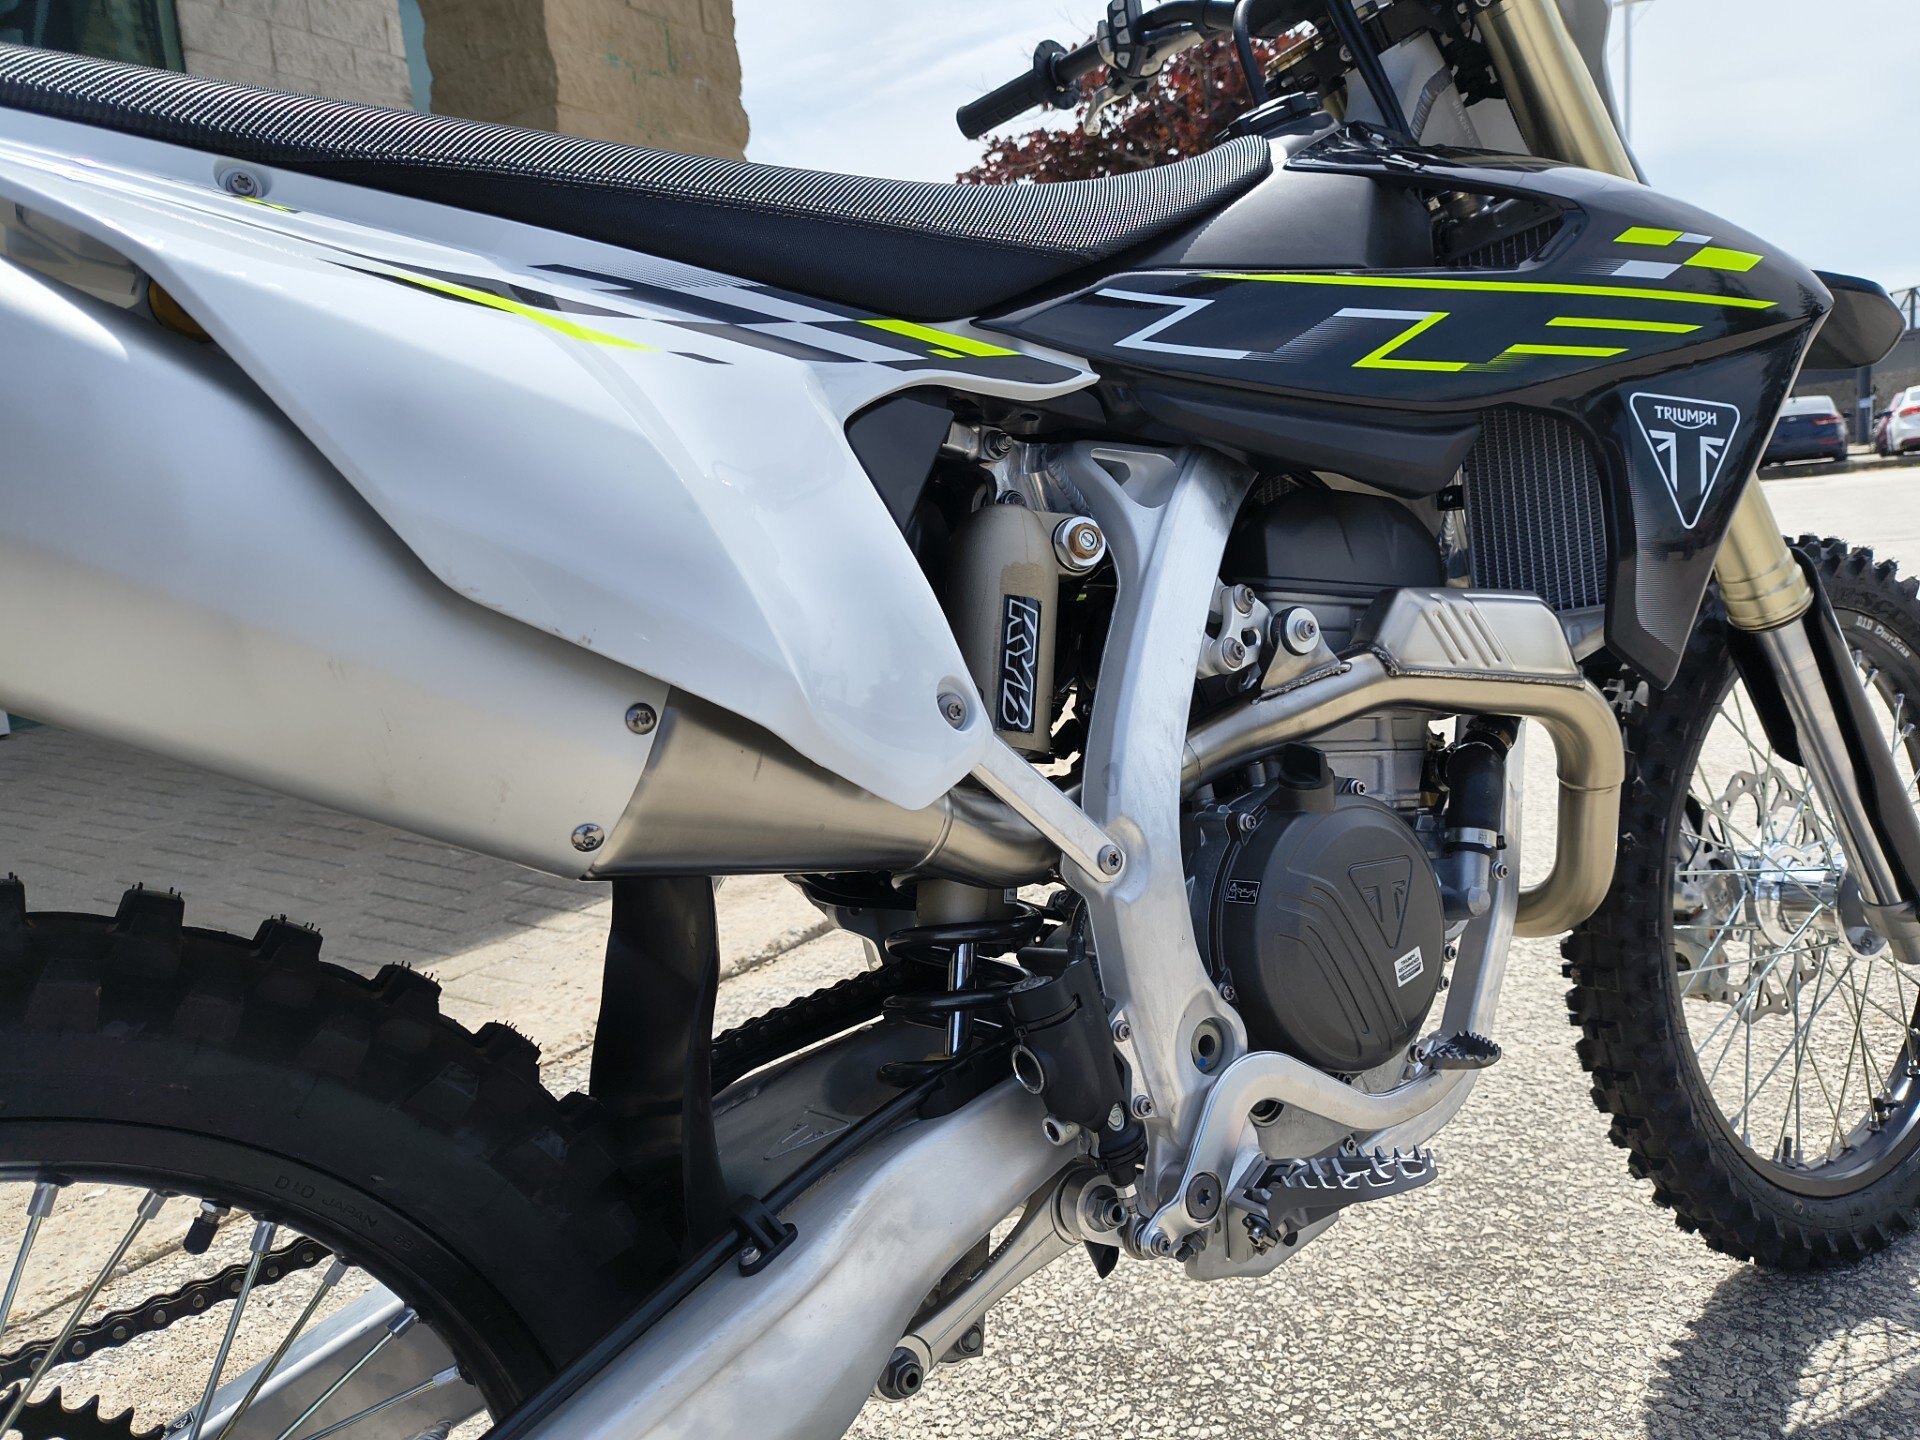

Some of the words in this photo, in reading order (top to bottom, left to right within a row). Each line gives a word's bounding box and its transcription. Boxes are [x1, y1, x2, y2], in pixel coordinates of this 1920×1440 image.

[1654, 405, 1717, 427] TRIUMPH
[1002, 598, 1038, 729] KYB
[322, 1198, 378, 1228] JAPAN
